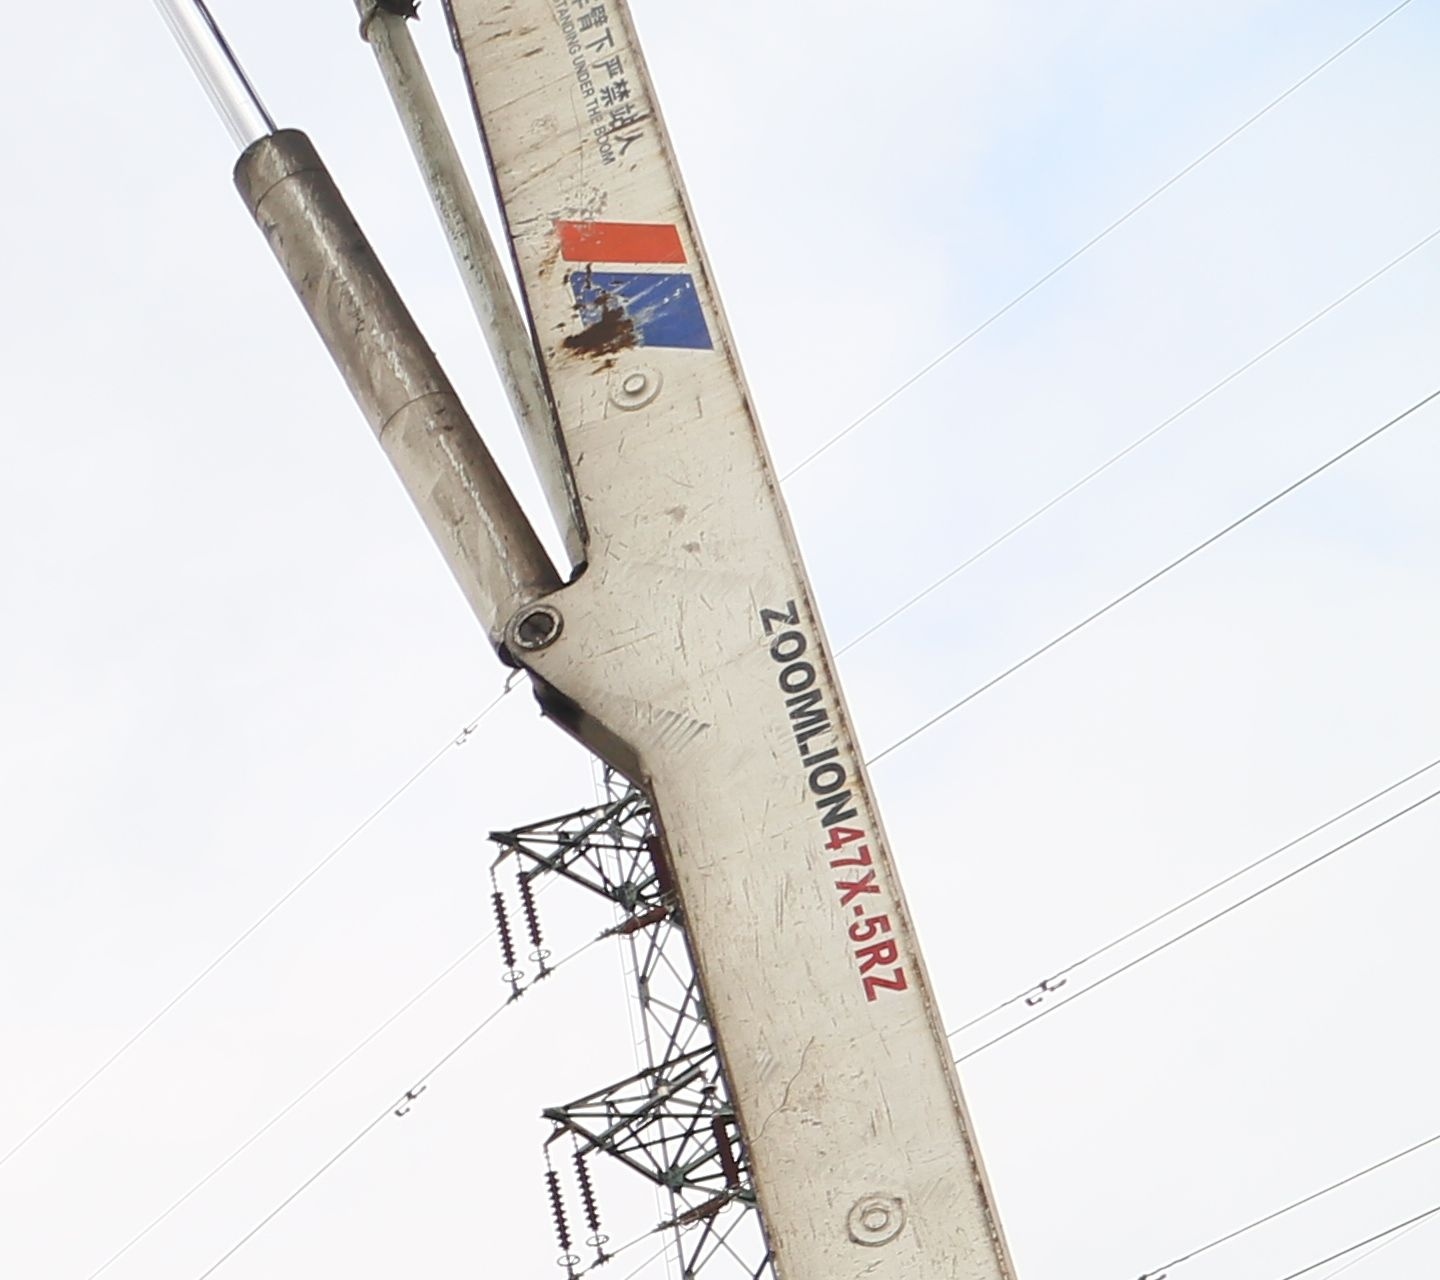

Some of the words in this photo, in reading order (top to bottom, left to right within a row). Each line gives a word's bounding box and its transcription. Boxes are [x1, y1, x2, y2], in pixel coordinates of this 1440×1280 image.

[554, 0, 580, 57] TANDING
[572, 55, 595, 98] UNDER
[586, 98, 604, 125] THE
